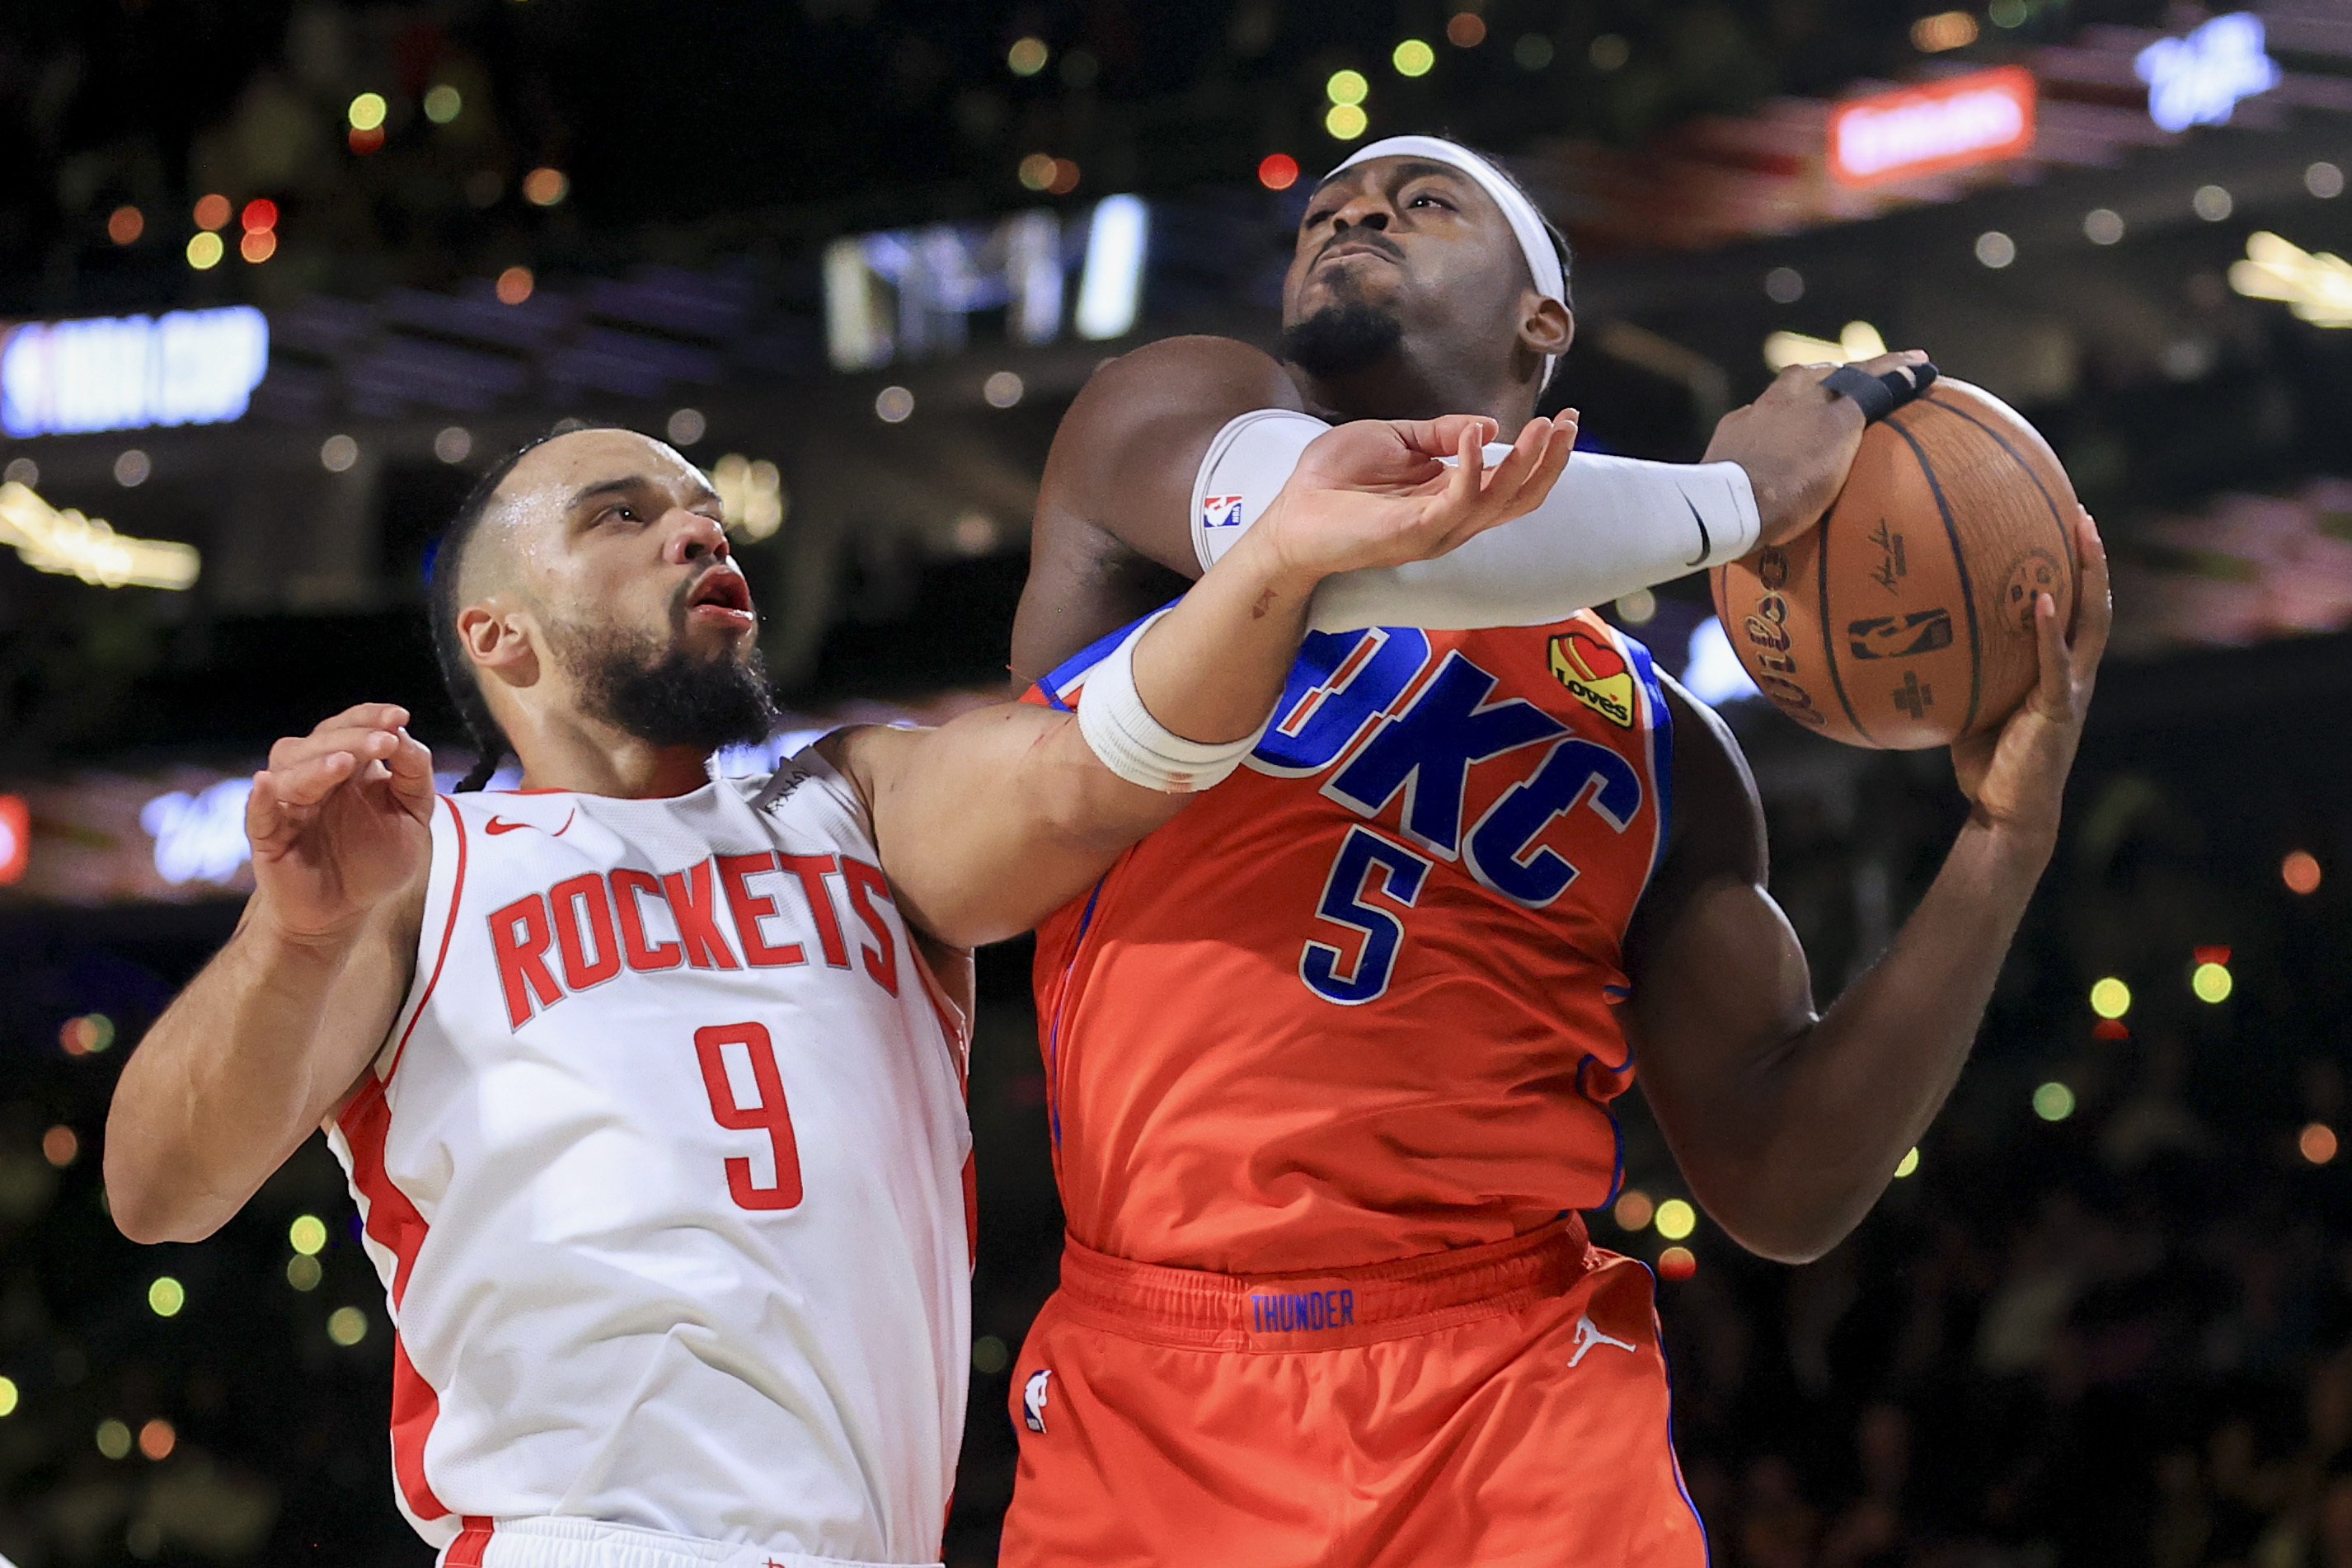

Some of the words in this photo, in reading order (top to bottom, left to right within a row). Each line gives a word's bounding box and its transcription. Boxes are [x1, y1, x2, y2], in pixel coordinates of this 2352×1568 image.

[1231, 505, 1241, 523] NBA
[1744, 544, 1828, 727] Wilso
[1241, 627, 1642, 908] OKC
[486, 849, 899, 1034] ROCKETS
[1298, 824, 1434, 1006] 5
[693, 1021, 804, 1211] 9
[1251, 1289, 1354, 1332] THUNDER
